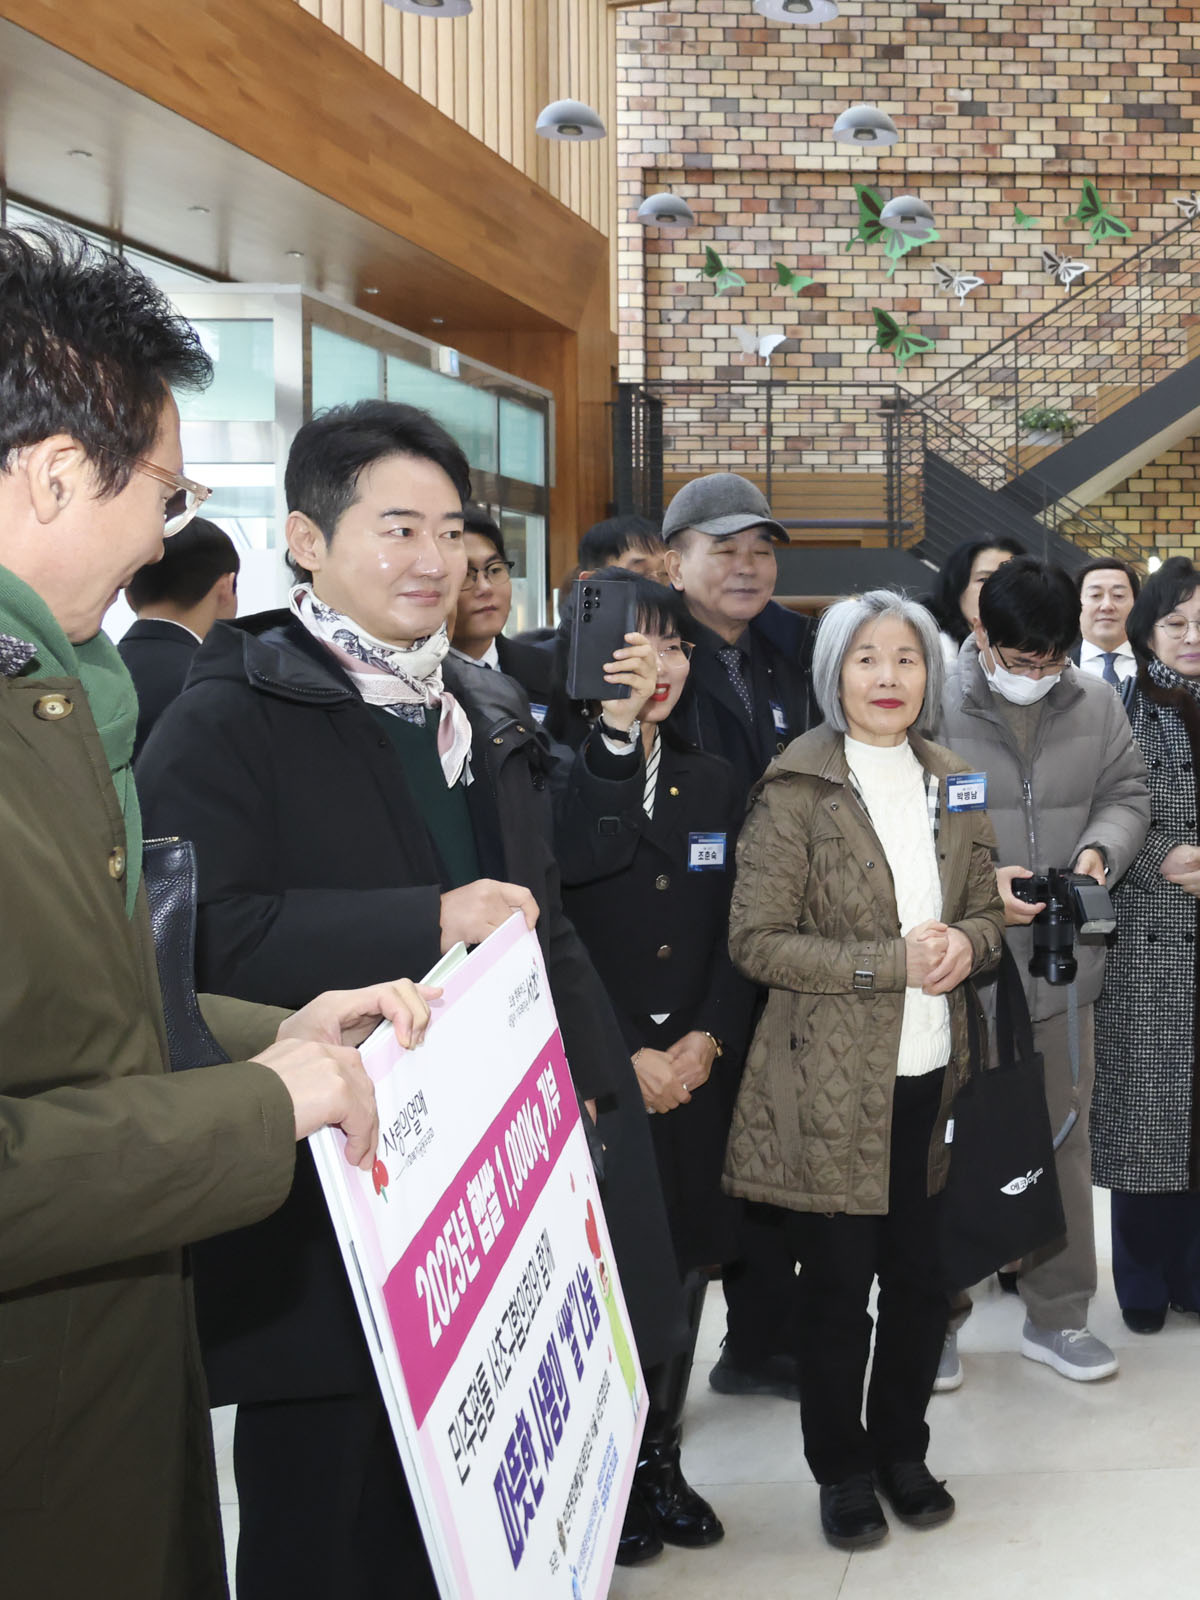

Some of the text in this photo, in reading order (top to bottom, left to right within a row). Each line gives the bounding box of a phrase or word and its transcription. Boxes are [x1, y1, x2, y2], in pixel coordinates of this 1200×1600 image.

[382, 1089, 429, 1157] 사랑의열매
[415, 1061, 562, 1348] 2025년 햅쌀 1,000Kg 기부
[447, 1230, 556, 1486] 민주평통 서초구협의회와 함께
[493, 1408, 545, 1571] 따뜻한
[528, 1332, 571, 1472] 사랑의
